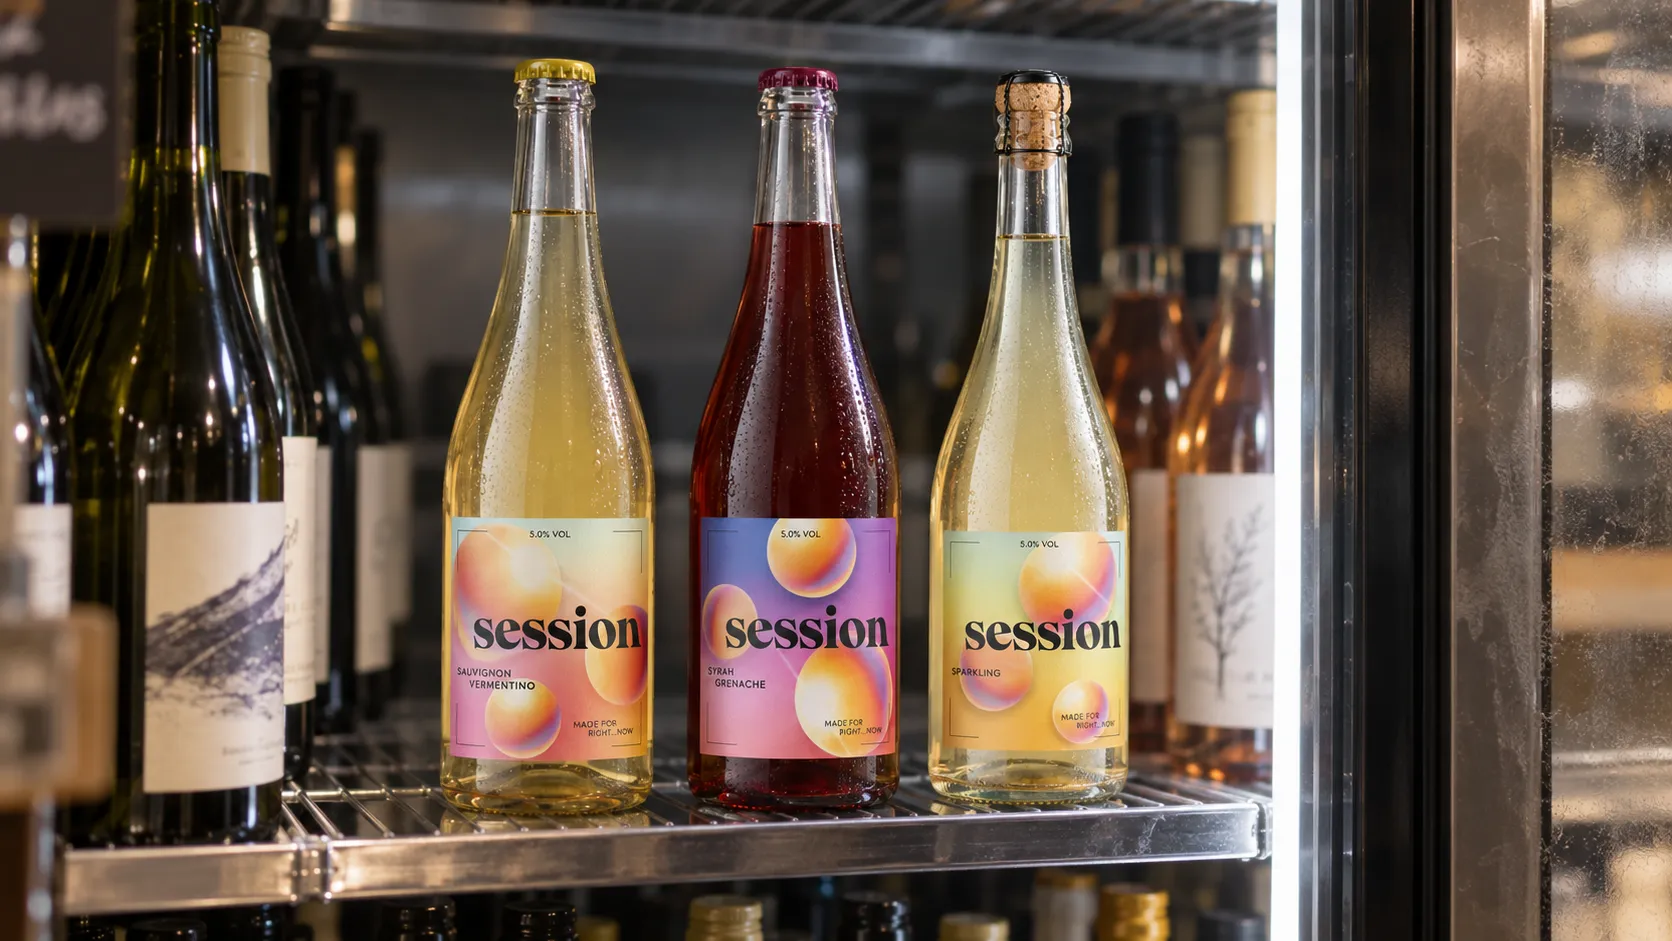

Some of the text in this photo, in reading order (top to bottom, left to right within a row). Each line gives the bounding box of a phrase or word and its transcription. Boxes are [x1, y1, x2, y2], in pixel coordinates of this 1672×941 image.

[529, 530, 571, 538] 5.0% VOL
[780, 530, 821, 538] 5.0% VOL
[1019, 540, 1059, 548] 5.0% VOL
[473, 605, 642, 651] session
[725, 604, 890, 649] session
[964, 608, 1122, 651] session
[456, 667, 512, 678] SAUVIGNON
[707, 666, 734, 676] SYRAH
[951, 667, 1001, 678] SPARKLING
[469, 679, 536, 690] VERMENTINO
[715, 679, 766, 689] GRENACHE
[1060, 712, 1100, 721] MADE FOR
[573, 719, 617, 728] MADE FOR
[824, 719, 848, 727] MADE
